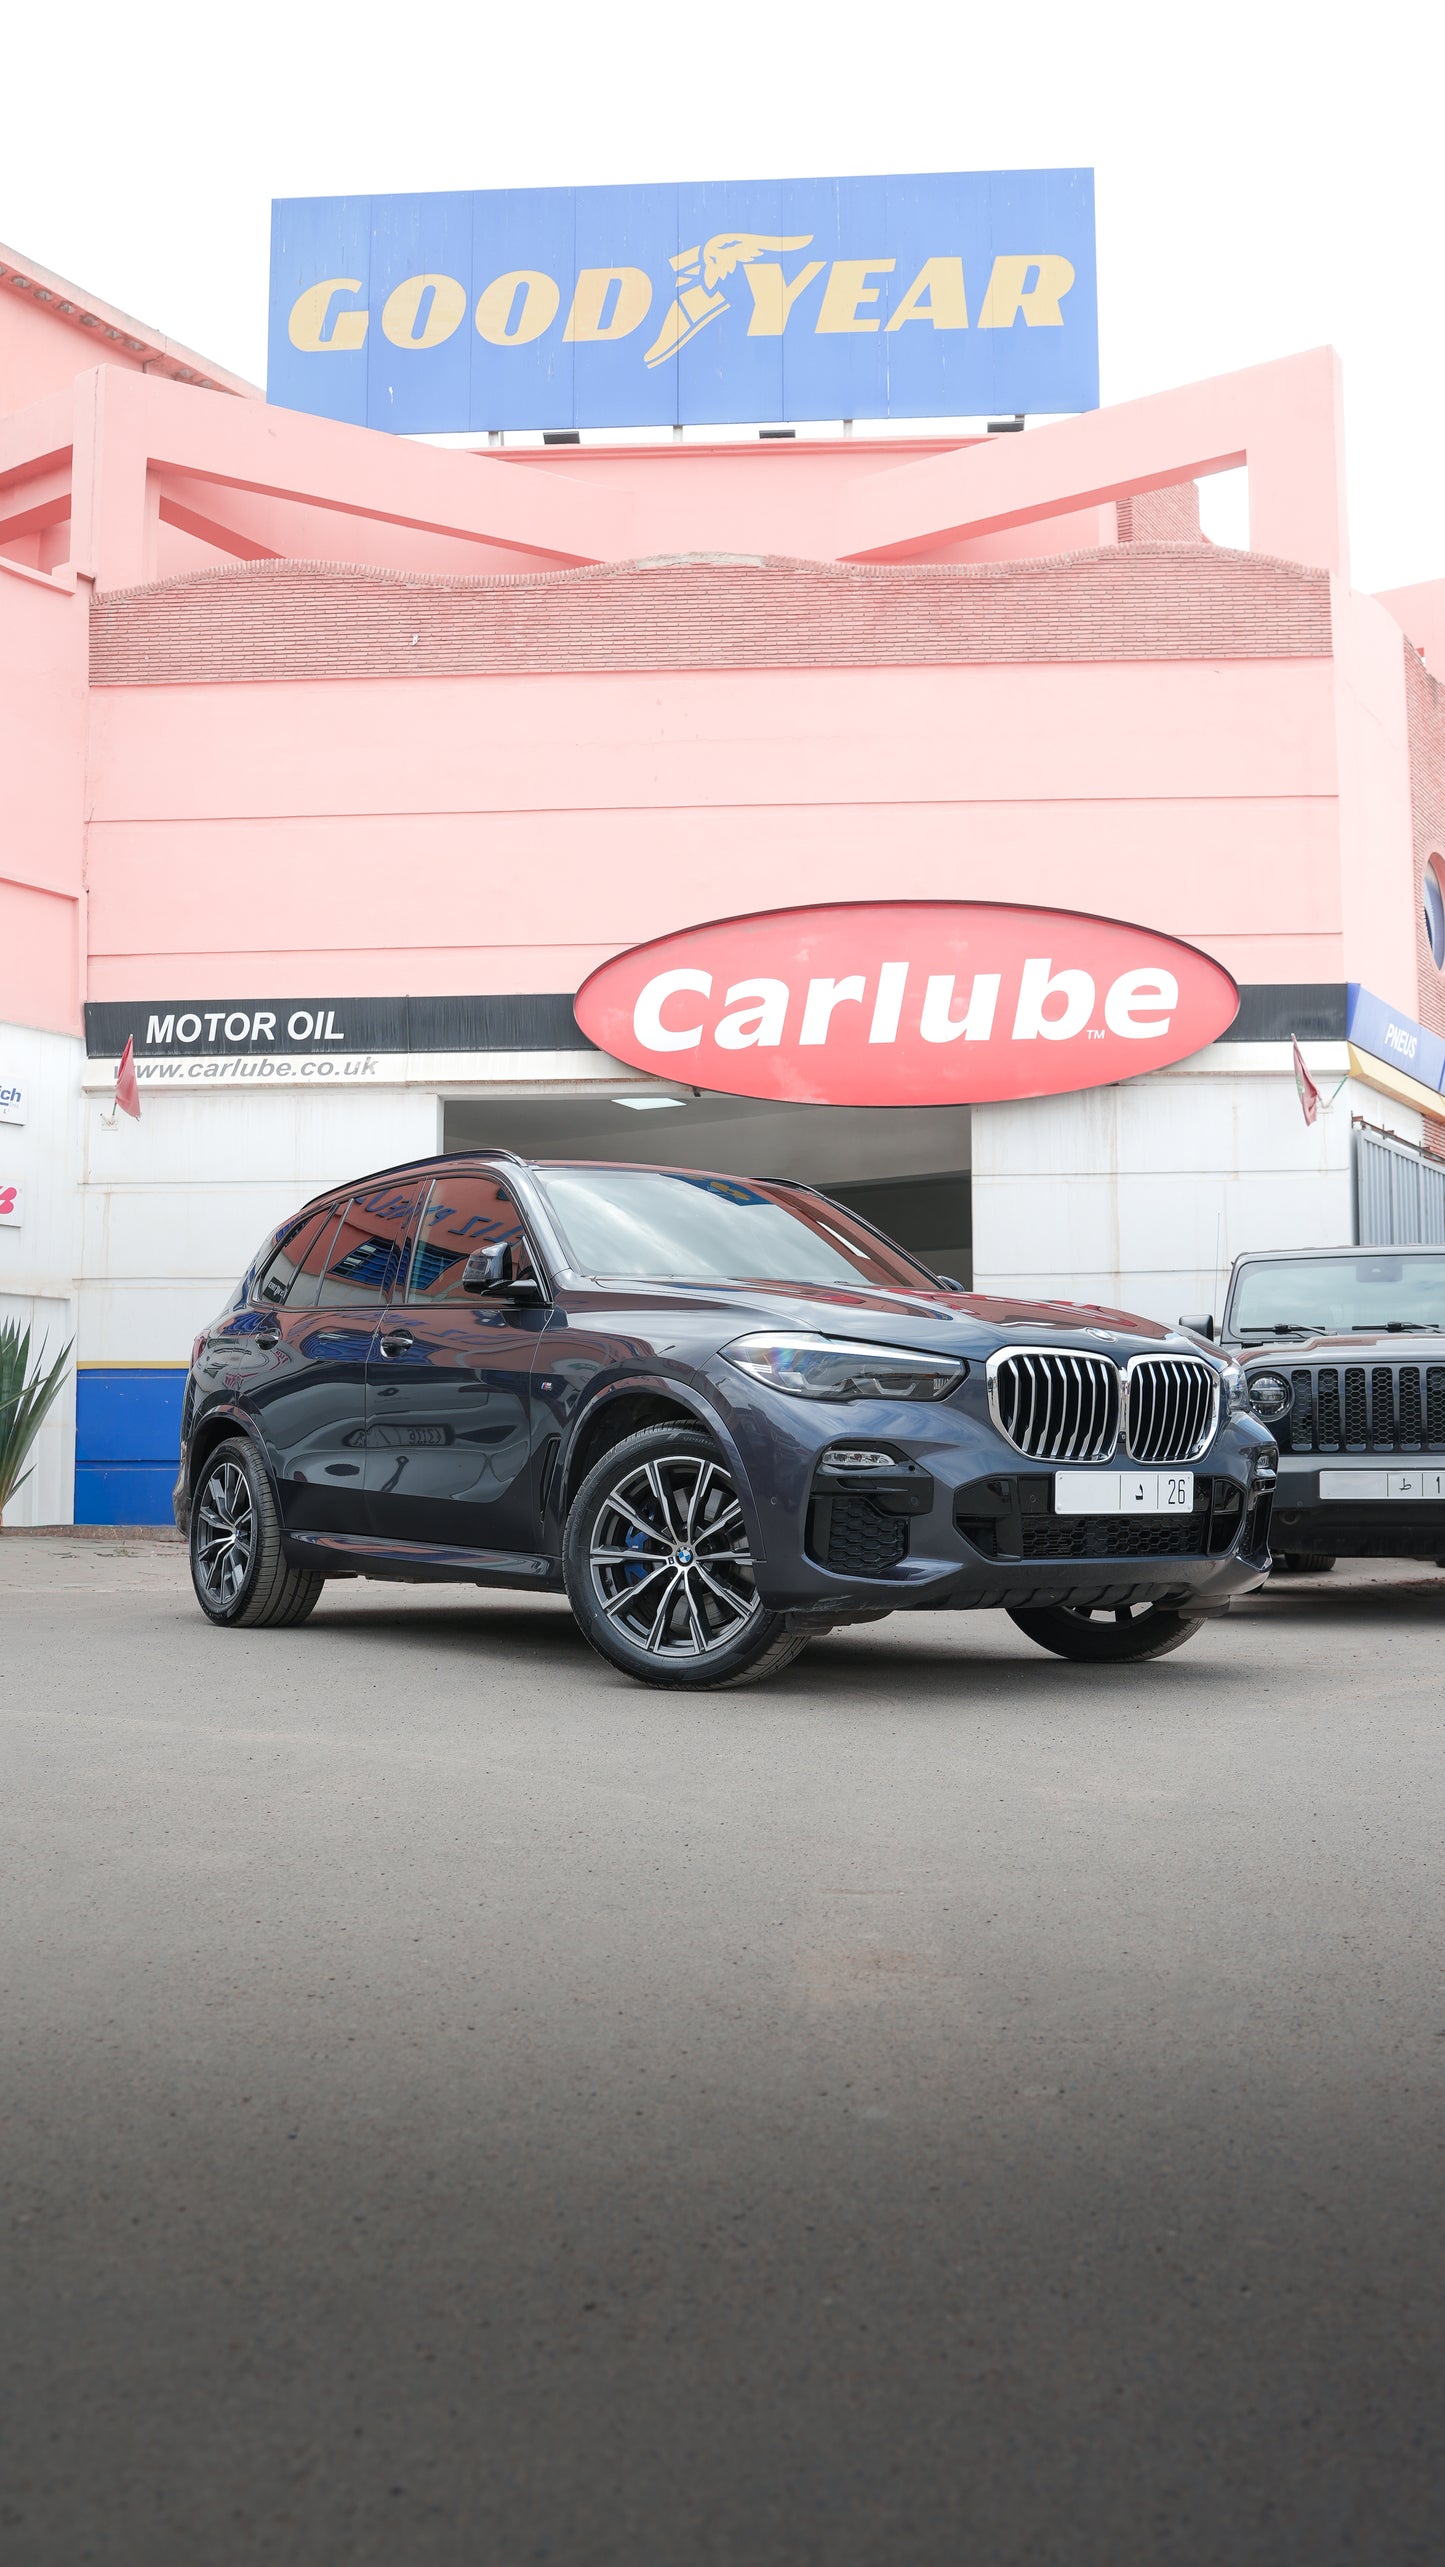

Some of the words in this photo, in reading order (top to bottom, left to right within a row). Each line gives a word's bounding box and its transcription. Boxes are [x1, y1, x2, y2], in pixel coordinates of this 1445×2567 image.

[632, 957, 1179, 1053] Carlube
[145, 1011, 277, 1044] MOTOR
[287, 1010, 345, 1041] OIL
[1384, 1023, 1418, 1059] PNEUS
[114, 1056, 379, 1080] ww.carlube.co.uk
[1167, 1479, 1186, 1505] 26
